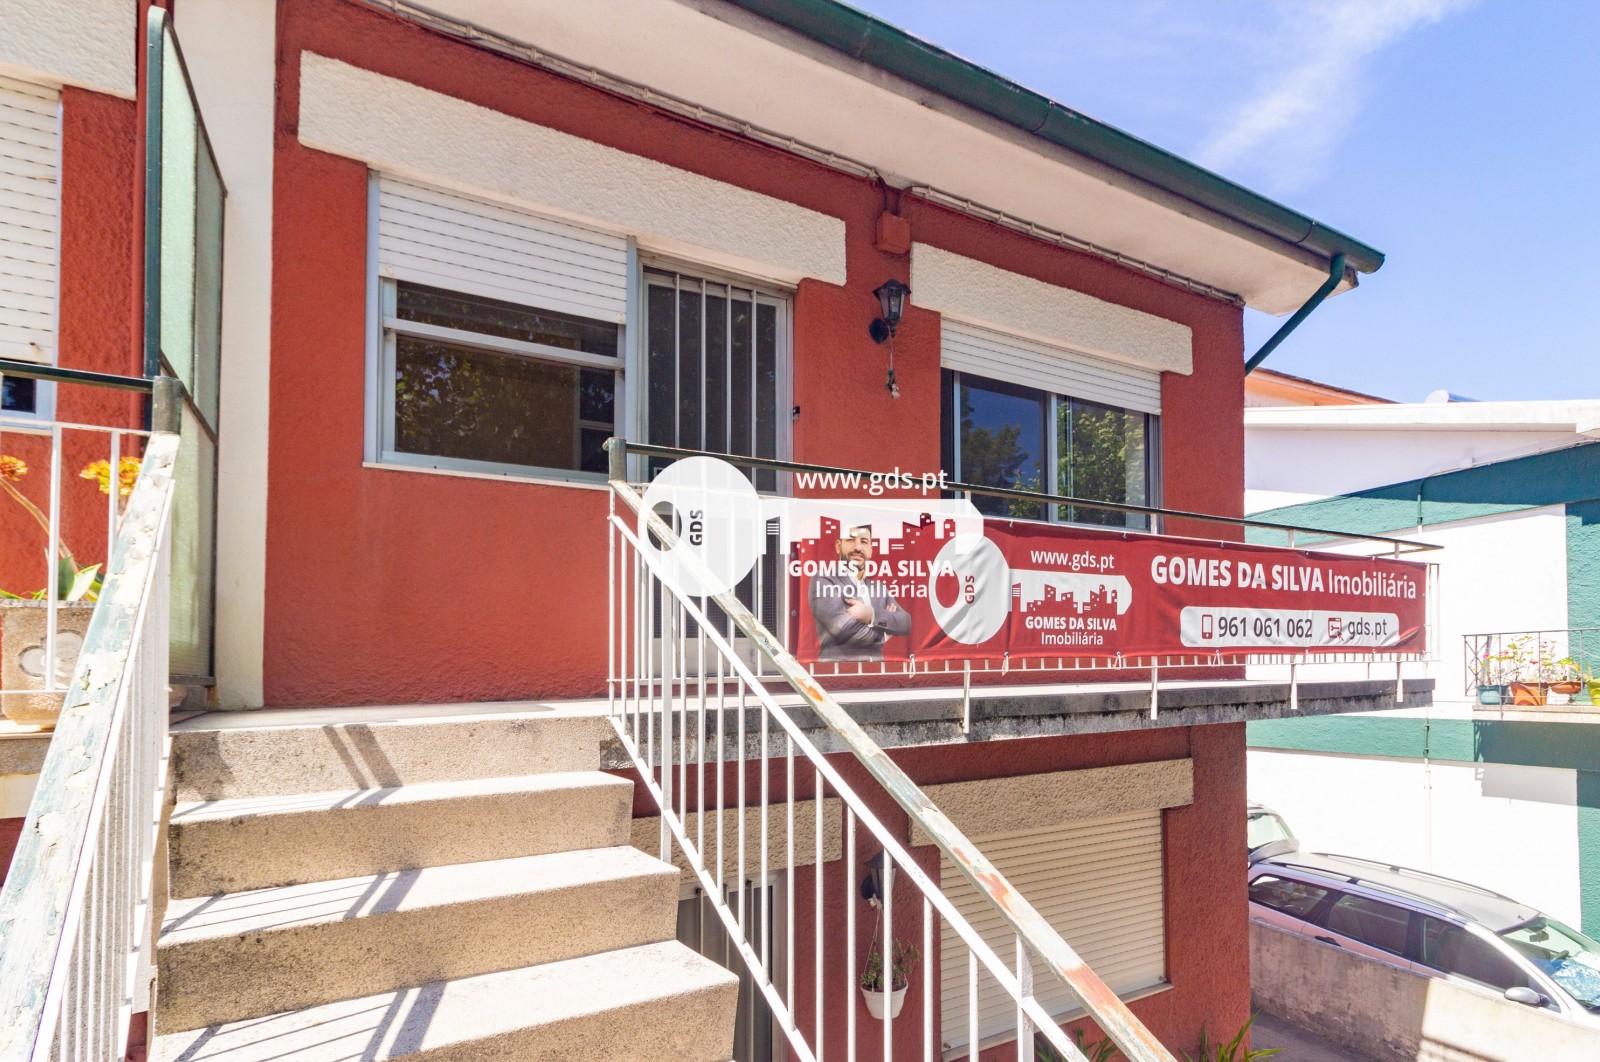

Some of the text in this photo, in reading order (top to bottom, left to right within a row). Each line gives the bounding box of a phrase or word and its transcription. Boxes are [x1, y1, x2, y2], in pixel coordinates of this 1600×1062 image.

[1030, 550, 1114, 572] www.gds.pt
[1151, 555, 1417, 600] GOMES DA SILVA Imobiliária
[965, 575, 976, 604] GDS
[1025, 616, 1117, 631] GOMES DA SILVA
[1218, 616, 1313, 639] 961 061 062
[1348, 617, 1388, 640] gds.pt
[1041, 631, 1104, 646] Imobiliária
